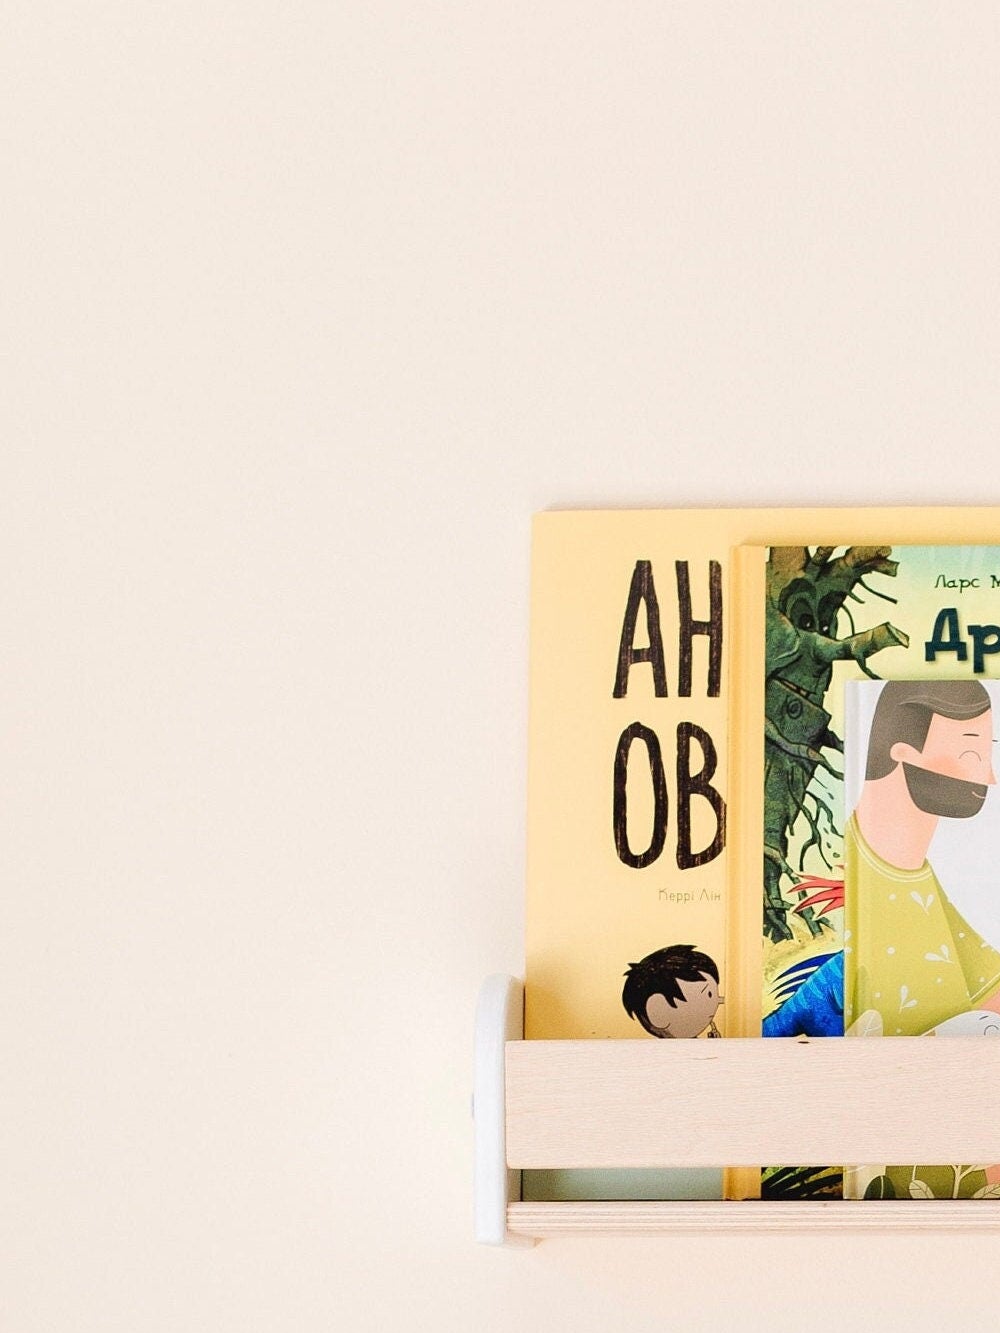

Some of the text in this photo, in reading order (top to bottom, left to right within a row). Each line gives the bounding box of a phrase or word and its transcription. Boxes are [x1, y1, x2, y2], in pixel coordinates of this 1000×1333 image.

[934, 574, 981, 594] Ларс
[612, 560, 724, 699] АН
[612, 721, 727, 870] ОВ
[658, 887, 694, 904] Керрі
